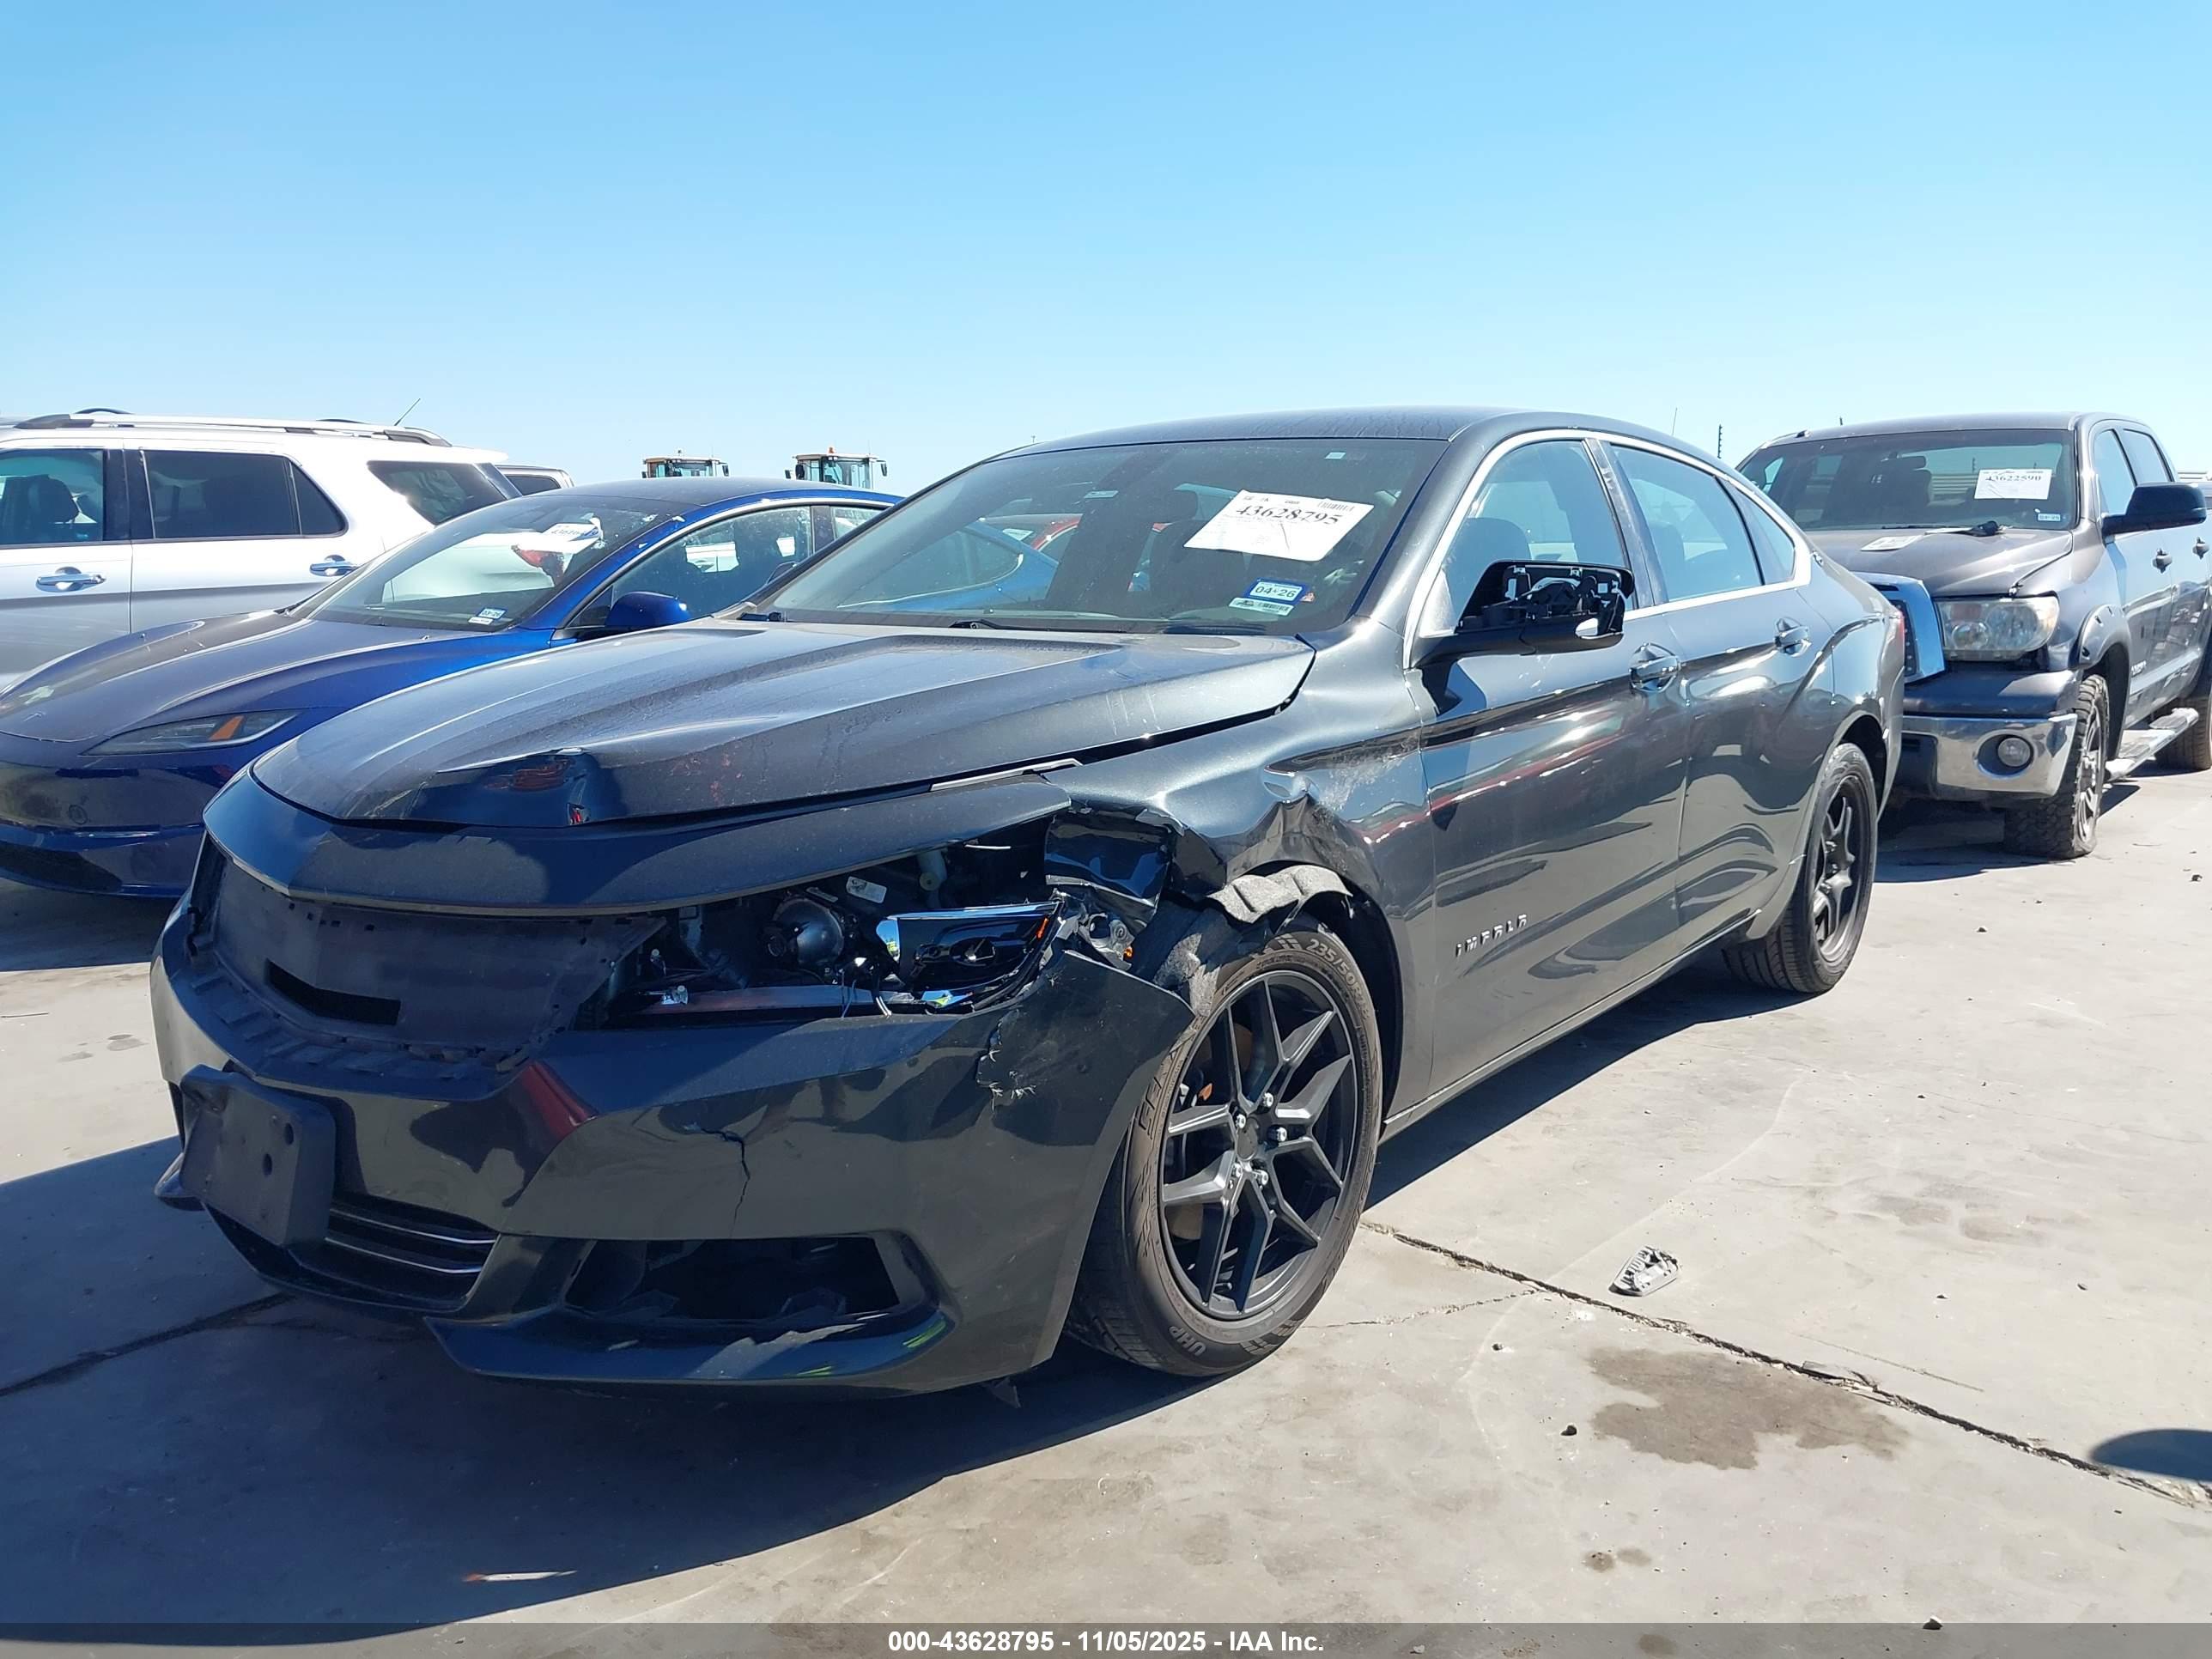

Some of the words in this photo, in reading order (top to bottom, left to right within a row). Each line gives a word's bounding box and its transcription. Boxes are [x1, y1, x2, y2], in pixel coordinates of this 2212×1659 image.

[1236, 504, 1344, 525] 43628795
[1455, 914, 1527, 957] IMPALA
[1167, 1325, 1206, 1357] UHP
